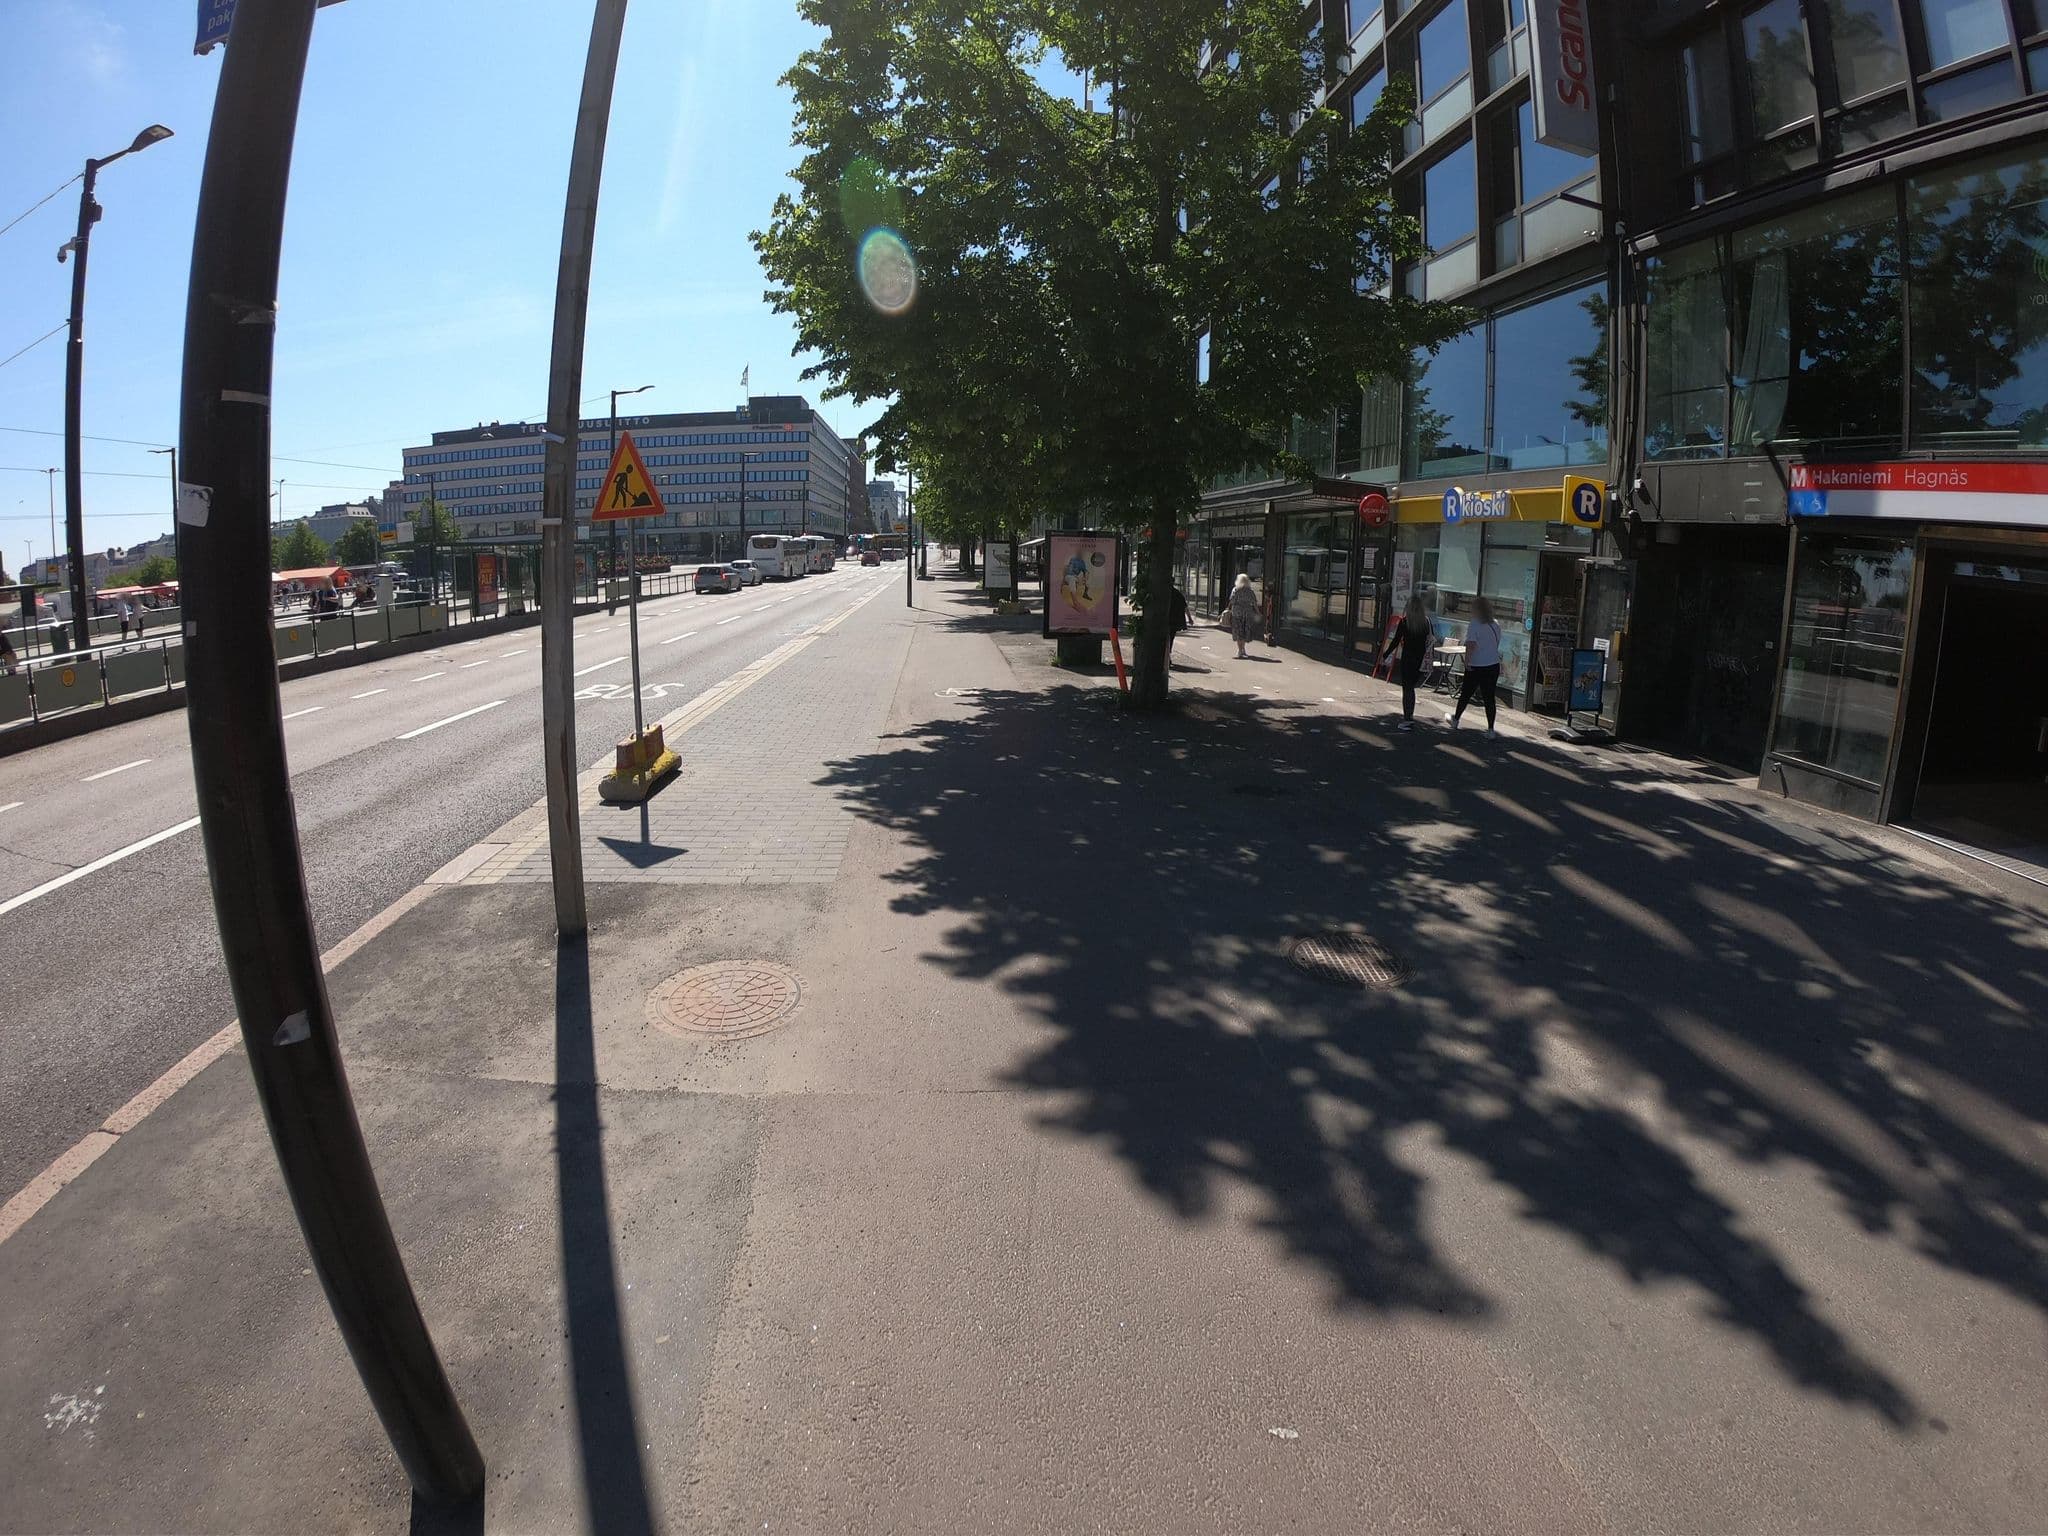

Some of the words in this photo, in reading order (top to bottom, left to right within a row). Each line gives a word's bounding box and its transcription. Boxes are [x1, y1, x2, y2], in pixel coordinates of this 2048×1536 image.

[208, 9, 231, 32] pak
[1556, 0, 1590, 112] Scan
[1812, 468, 1892, 486] Hakaniemi
[1904, 468, 1968, 487] Hagnäs
[1446, 494, 1457, 517] R
[1462, 491, 1506, 518] kioski
[1580, 488, 1597, 516] R
[574, 682, 685, 700] BUS
